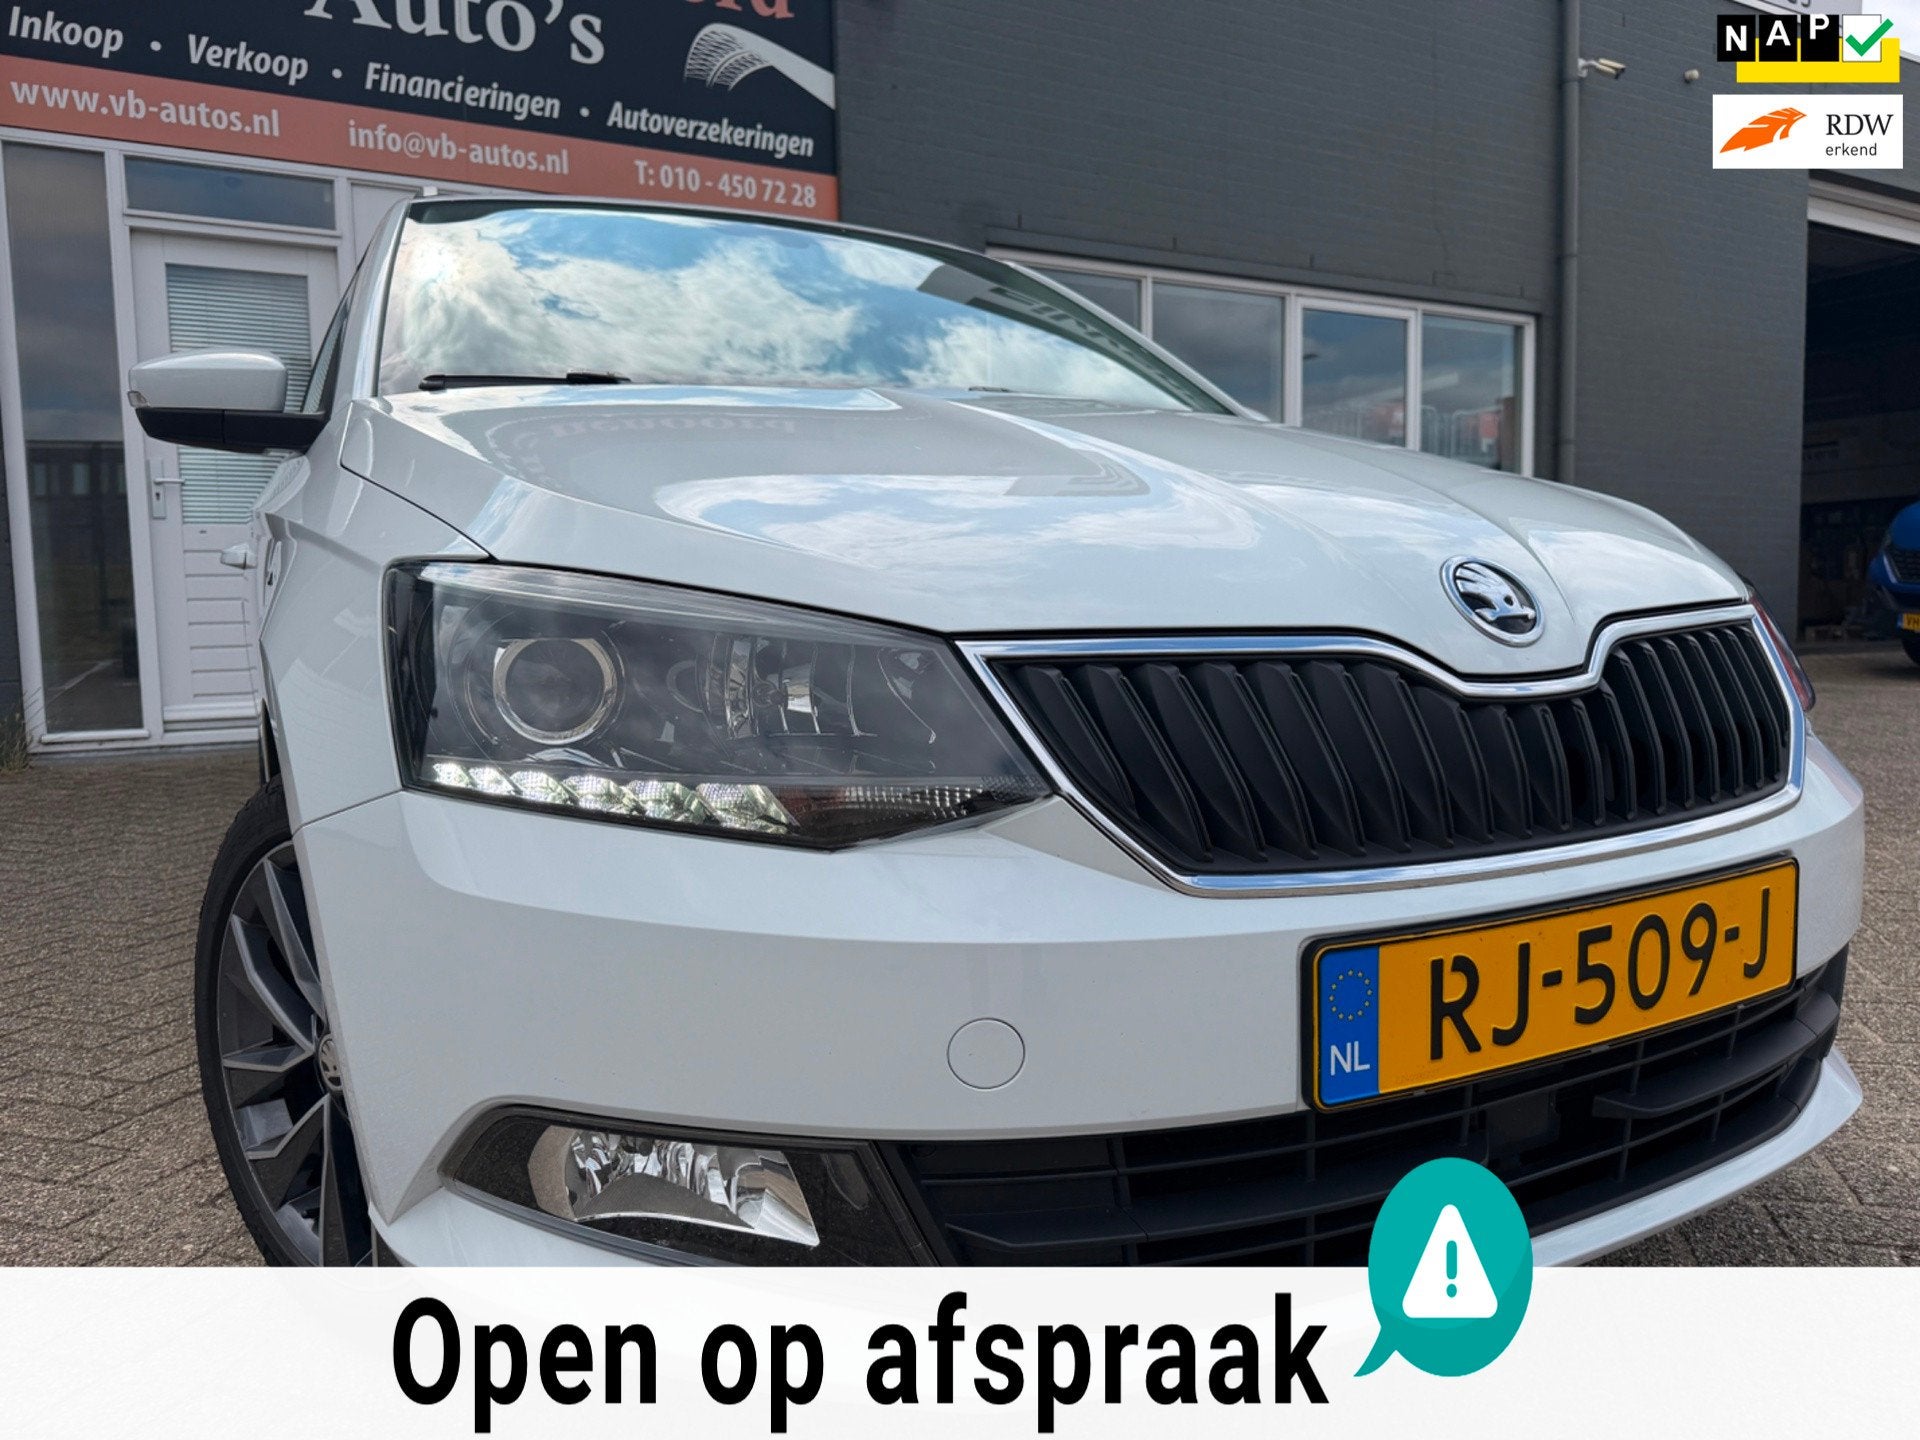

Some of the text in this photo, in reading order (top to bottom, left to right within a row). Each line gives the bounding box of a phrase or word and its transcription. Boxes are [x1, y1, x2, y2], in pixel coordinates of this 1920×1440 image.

[8, 6, 814, 159] Inkoop Verkoop Financieringen Autoverzekeringen
[10, 80, 280, 137] www.vb-autos.nl
[348, 119, 570, 175] info@vb-autos.nl
[634, 160, 655, 186] T:
[659, 165, 701, 192] 010
[717, 173, 757, 200] 450
[761, 179, 787, 205] 72
[790, 183, 817, 208] 28
[1429, 887, 1771, 1061] RJ-509-J
[1330, 1041, 1371, 1076] NL
